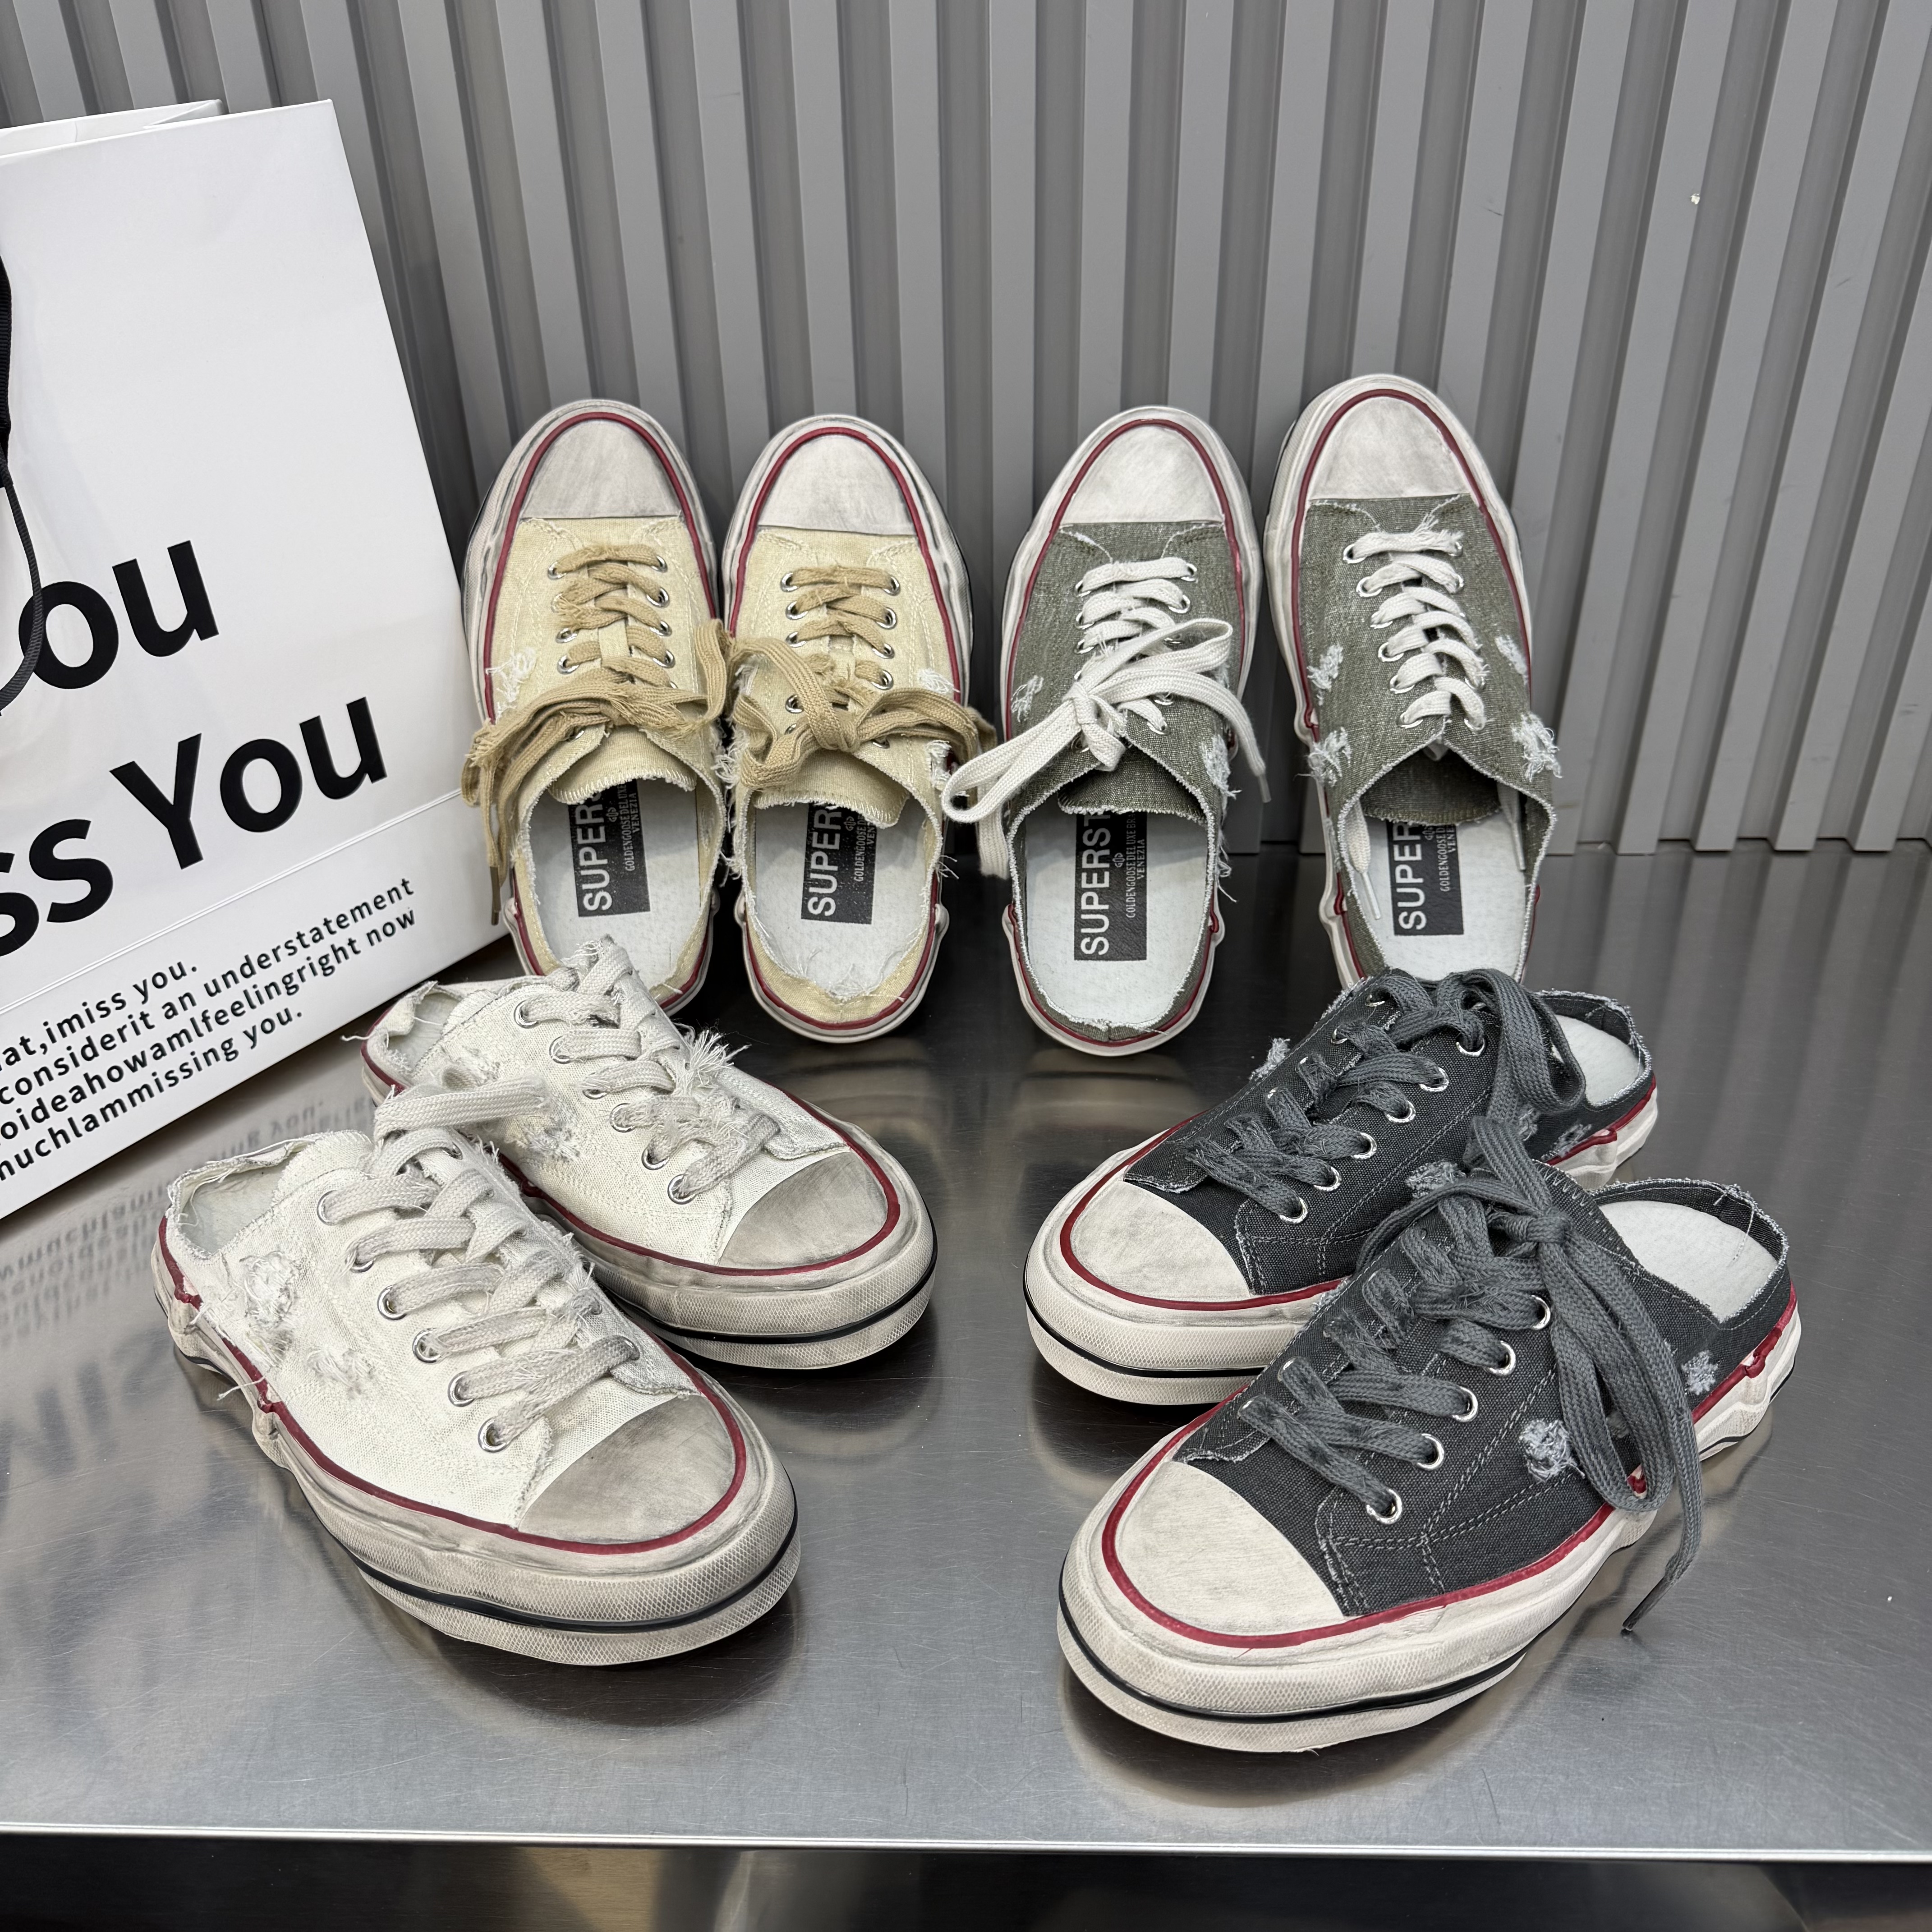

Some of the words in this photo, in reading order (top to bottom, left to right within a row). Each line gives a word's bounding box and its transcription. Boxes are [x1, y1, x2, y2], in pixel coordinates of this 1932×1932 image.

[109, 697, 387, 870] You
[629, 792, 640, 833] VENEZIA
[1136, 839, 1145, 879] VENEZIA
[366, 910, 414, 946] now
[161, 992, 196, 1020] an
[203, 879, 414, 997] understatement
[0, 993, 126, 1072] at,imiss
[133, 962, 197, 1005] you.
[243, 1008, 303, 1049] you.
